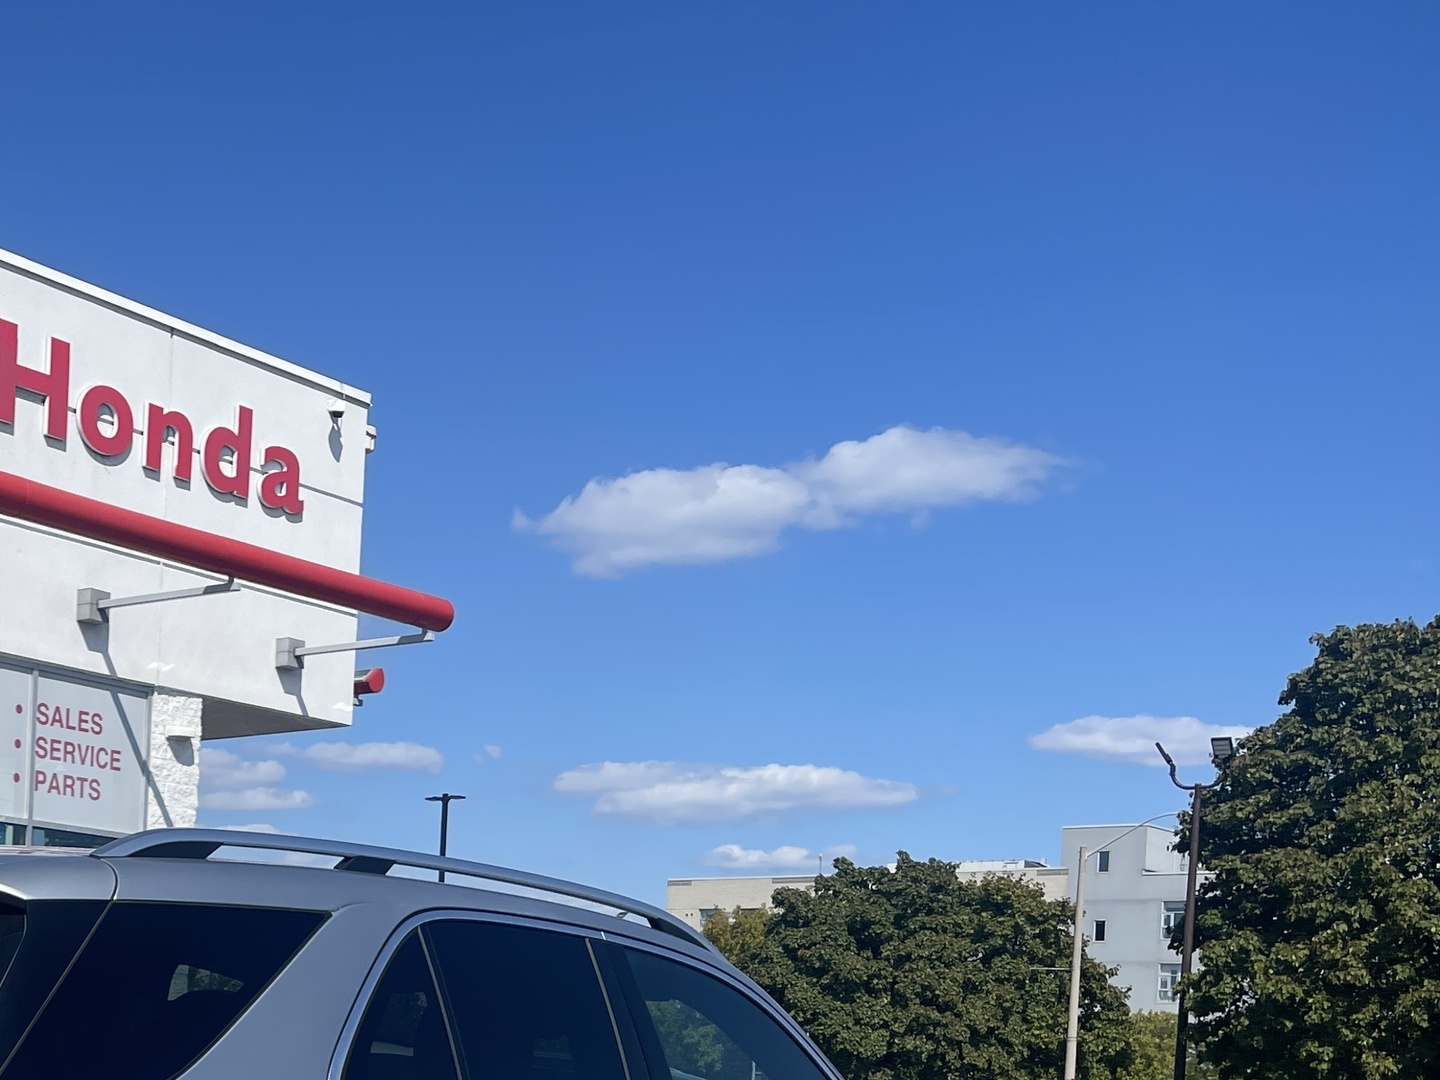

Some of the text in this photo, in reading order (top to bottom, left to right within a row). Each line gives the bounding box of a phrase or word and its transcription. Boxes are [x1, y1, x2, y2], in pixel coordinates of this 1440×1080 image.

[36, 702, 103, 735] SALES
[35, 736, 122, 772] SERVICE
[35, 770, 101, 801] PARTS
